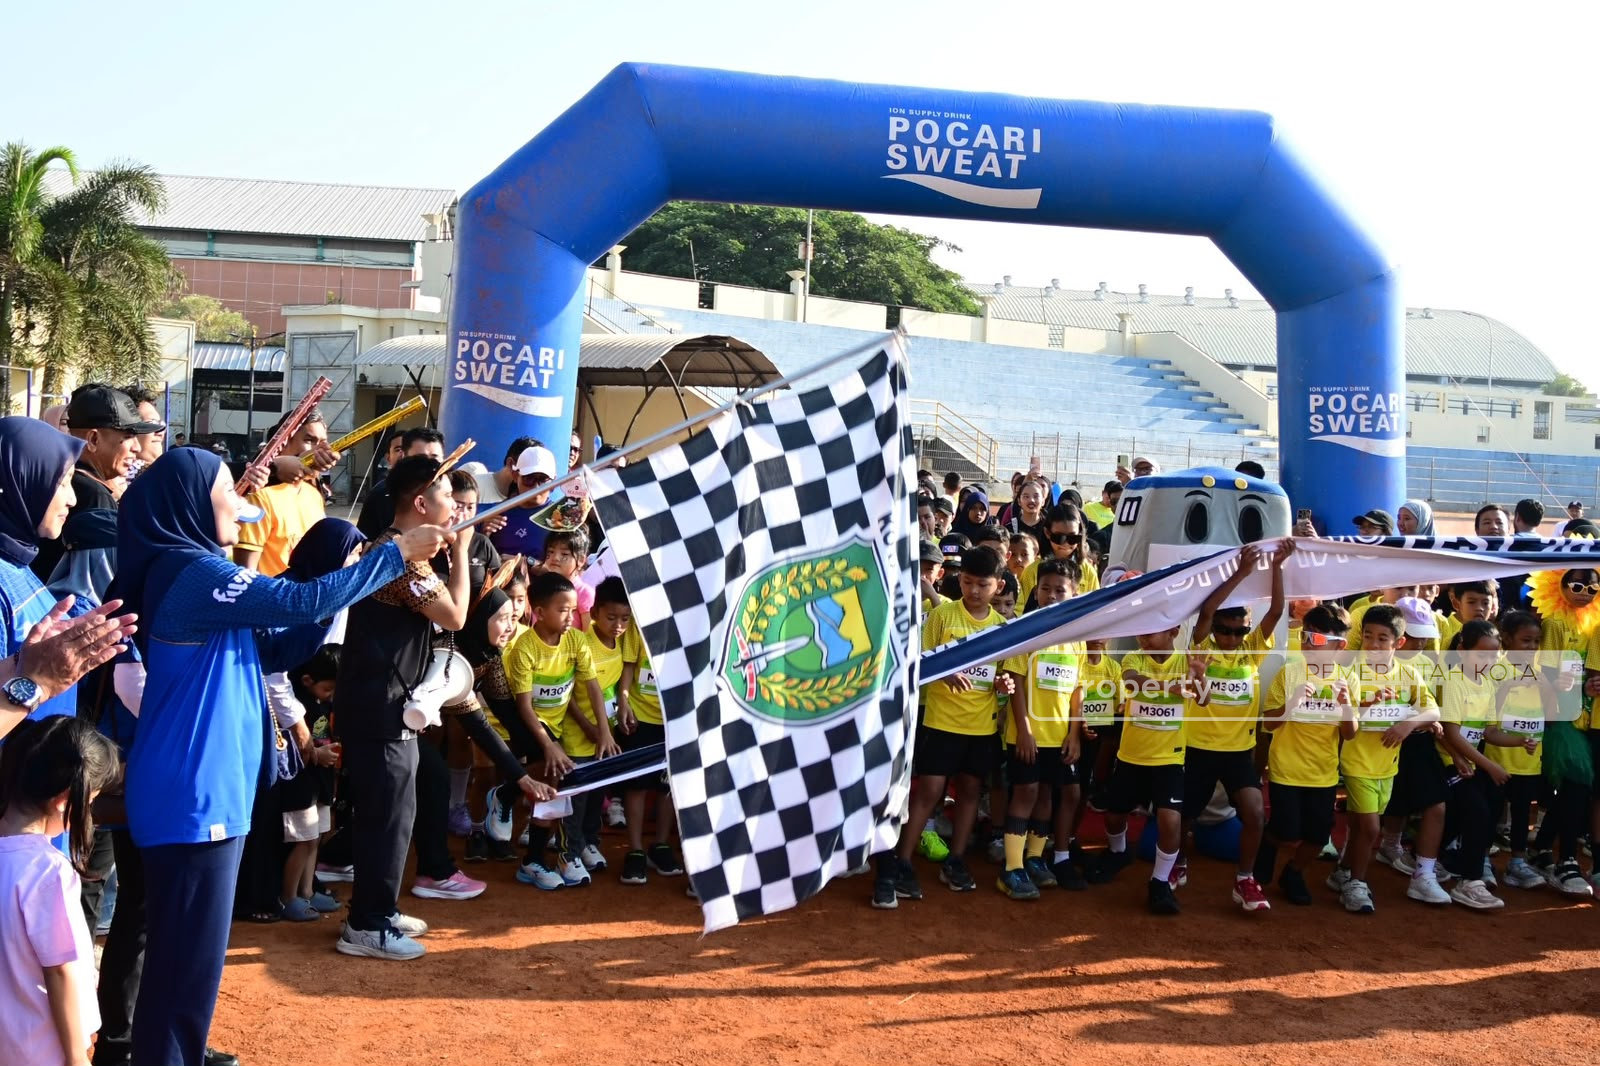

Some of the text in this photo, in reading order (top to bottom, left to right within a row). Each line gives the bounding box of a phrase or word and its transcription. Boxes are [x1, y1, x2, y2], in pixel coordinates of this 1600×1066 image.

[909, 109, 941, 118] SUPPLY
[944, 111, 972, 120] DRINK
[888, 116, 1041, 153] POCARI
[886, 143, 1026, 179] SWEAT
[494, 333, 516, 341] DRINK
[456, 339, 565, 370] POCARI
[455, 360, 555, 389] SWEAT
[1309, 413, 1400, 434] SWEAT
[1210, 681, 1248, 692] M3050
[1139, 705, 1175, 717] M3061
[1299, 701, 1336, 712] M3126
[1369, 707, 1400, 718] F3122
[1513, 720, 1540, 730] F3101
